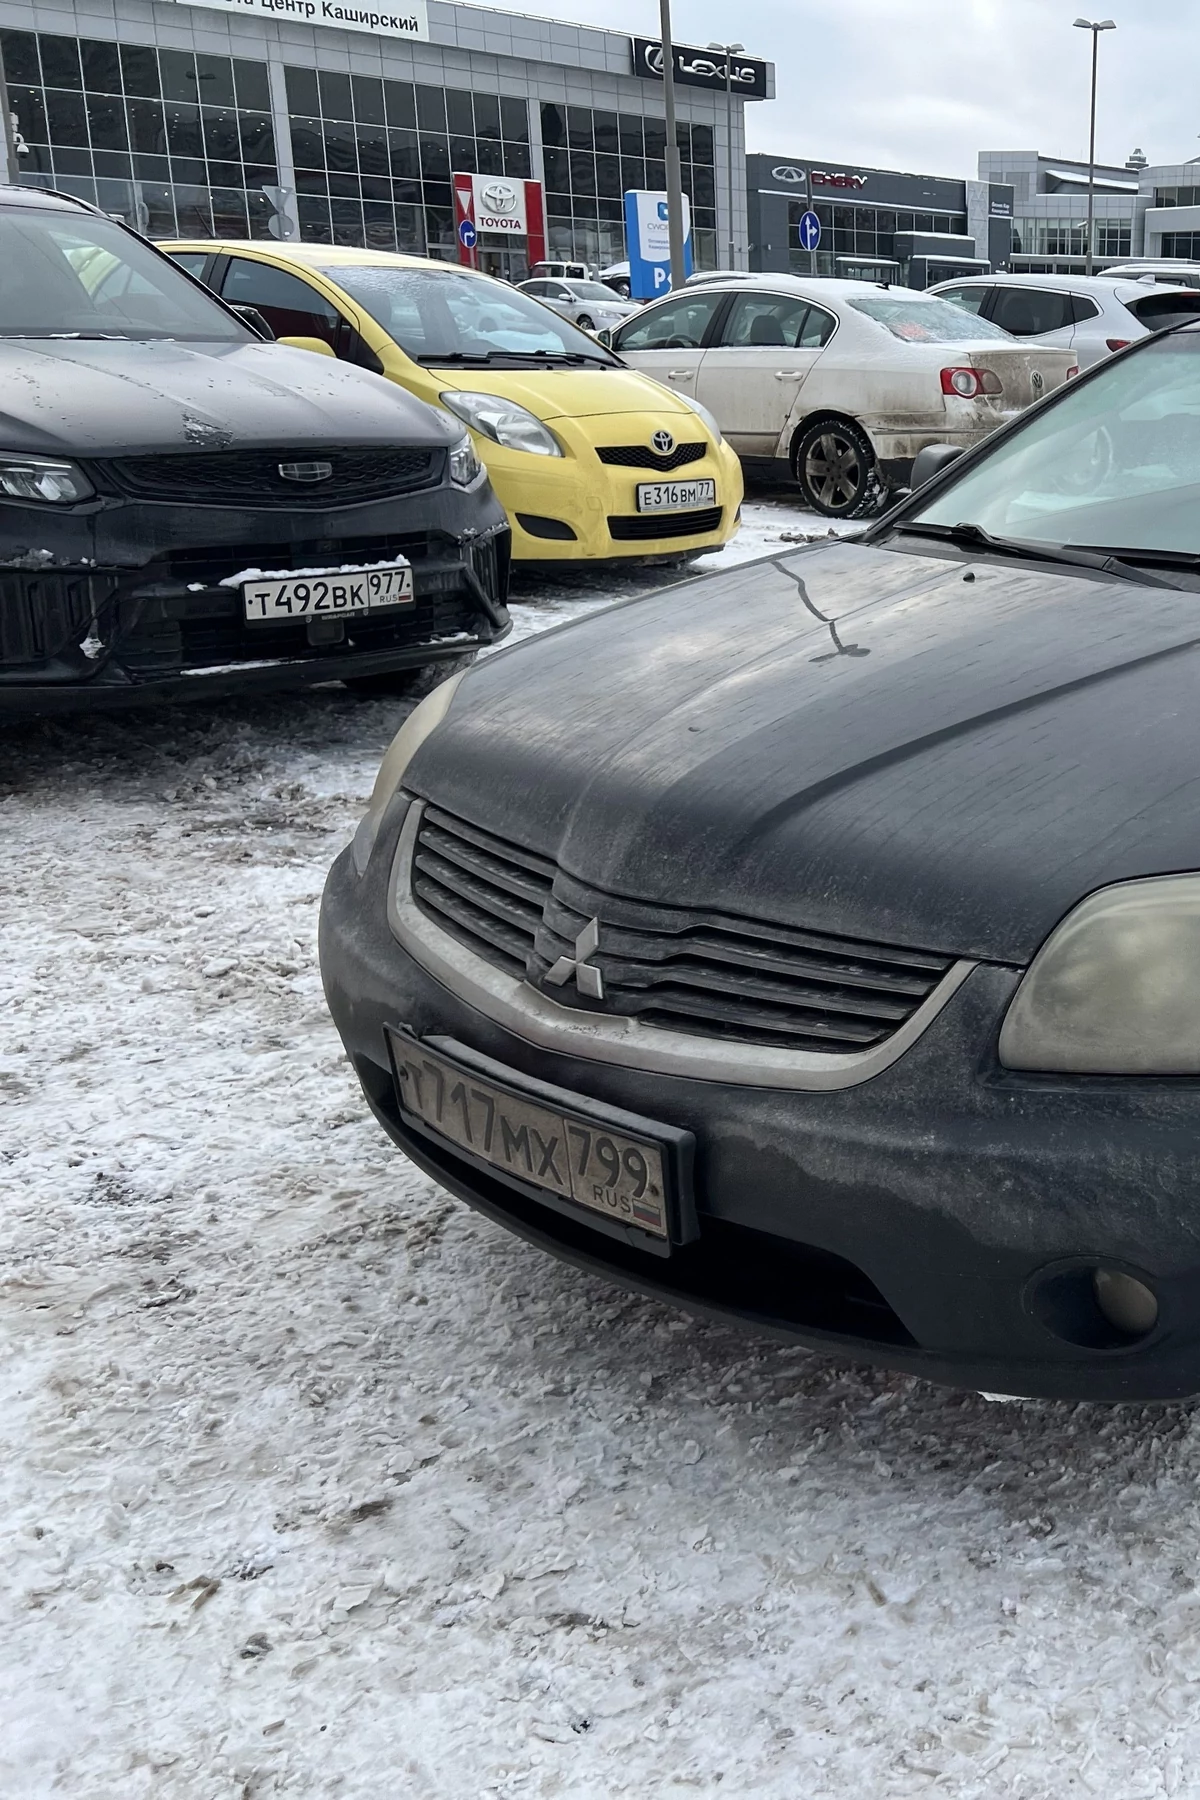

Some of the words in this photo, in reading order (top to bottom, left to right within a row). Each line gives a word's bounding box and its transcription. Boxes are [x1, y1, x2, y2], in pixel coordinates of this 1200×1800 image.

[322, 2, 419, 32] Каширский
[679, 55, 756, 83] LEXUS
[479, 216, 521, 230] TOYOTA
[370, 571, 405, 596] 977
[568, 1125, 649, 1199] 799
[592, 1183, 632, 1214] RUS
